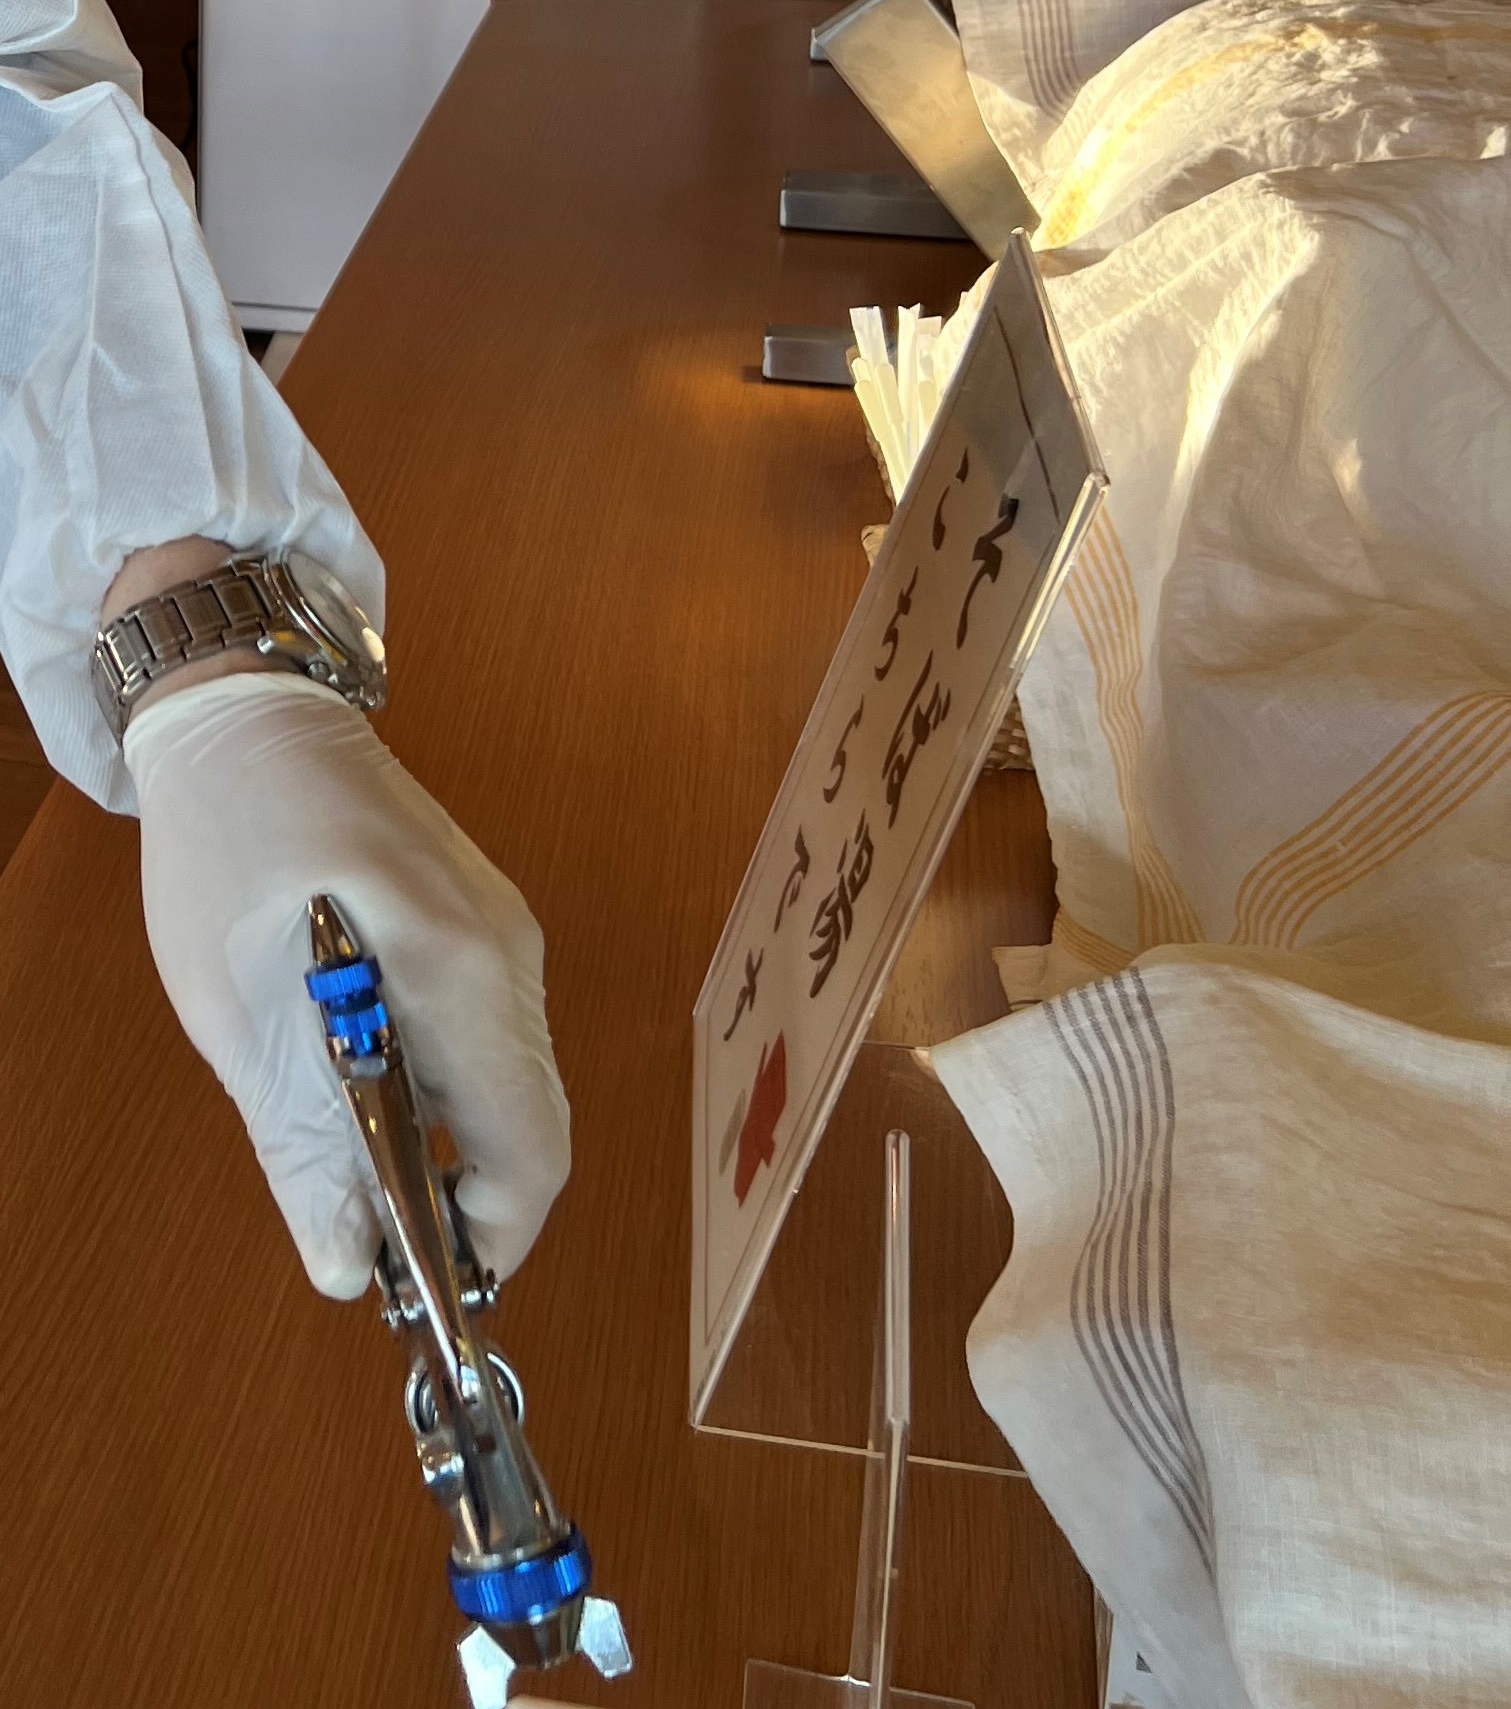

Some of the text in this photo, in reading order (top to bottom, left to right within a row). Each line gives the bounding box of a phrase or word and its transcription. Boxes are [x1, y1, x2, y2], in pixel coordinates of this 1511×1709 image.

[723, 446, 971, 1044] こちらです
